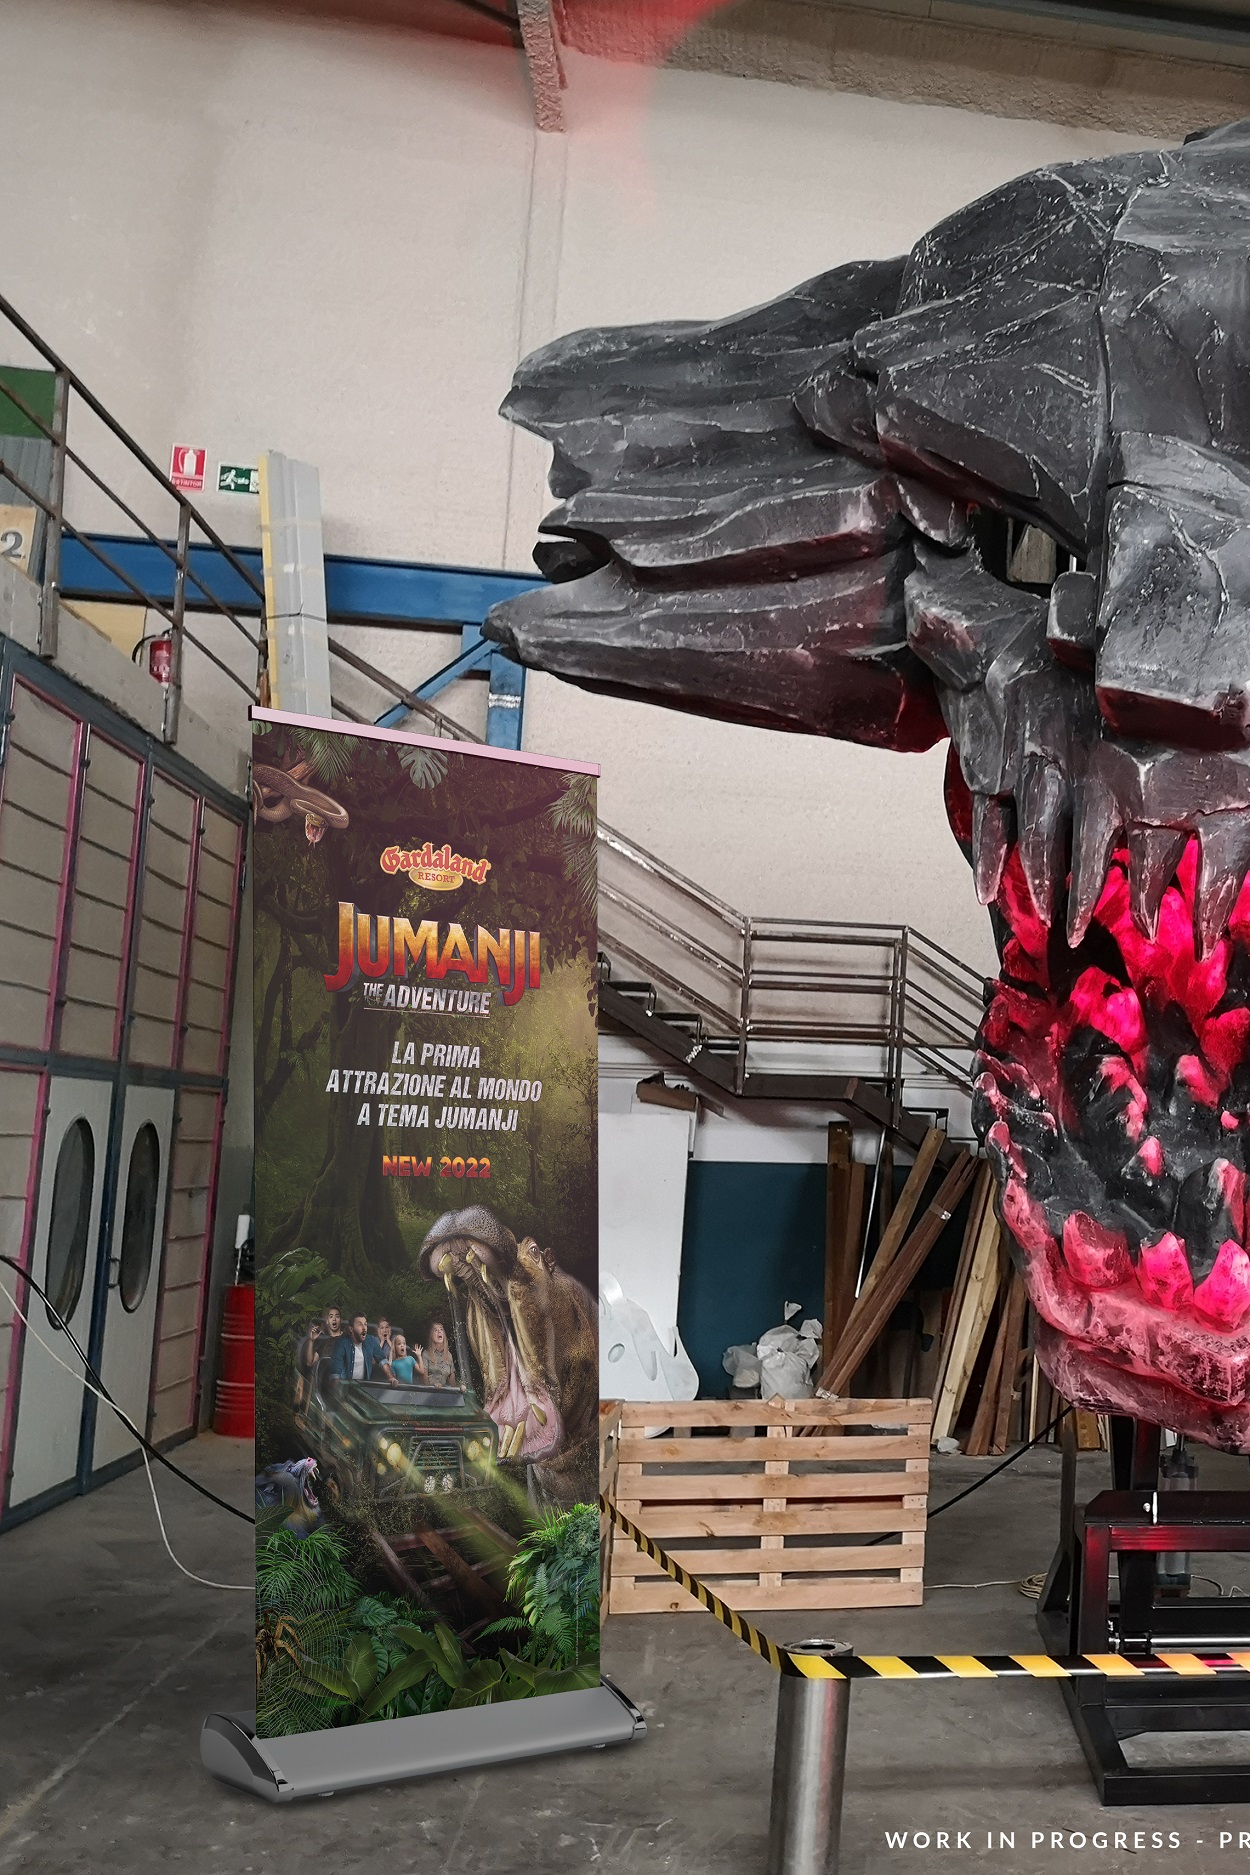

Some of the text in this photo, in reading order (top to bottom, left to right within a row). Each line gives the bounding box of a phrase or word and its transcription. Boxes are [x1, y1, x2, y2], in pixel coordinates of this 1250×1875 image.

[381, 842, 489, 884] Gardaland
[417, 871, 456, 884] RESORT
[323, 901, 541, 1006] JUMANJI
[363, 982, 492, 1014] THE ADVENTURE
[391, 1041, 480, 1068] LA PRIMA
[325, 1069, 543, 1102] ATTRAZIONE AL MONDO
[356, 1103, 519, 1131] A TEMA JUMANJI
[382, 1155, 491, 1178] NEW 2022
